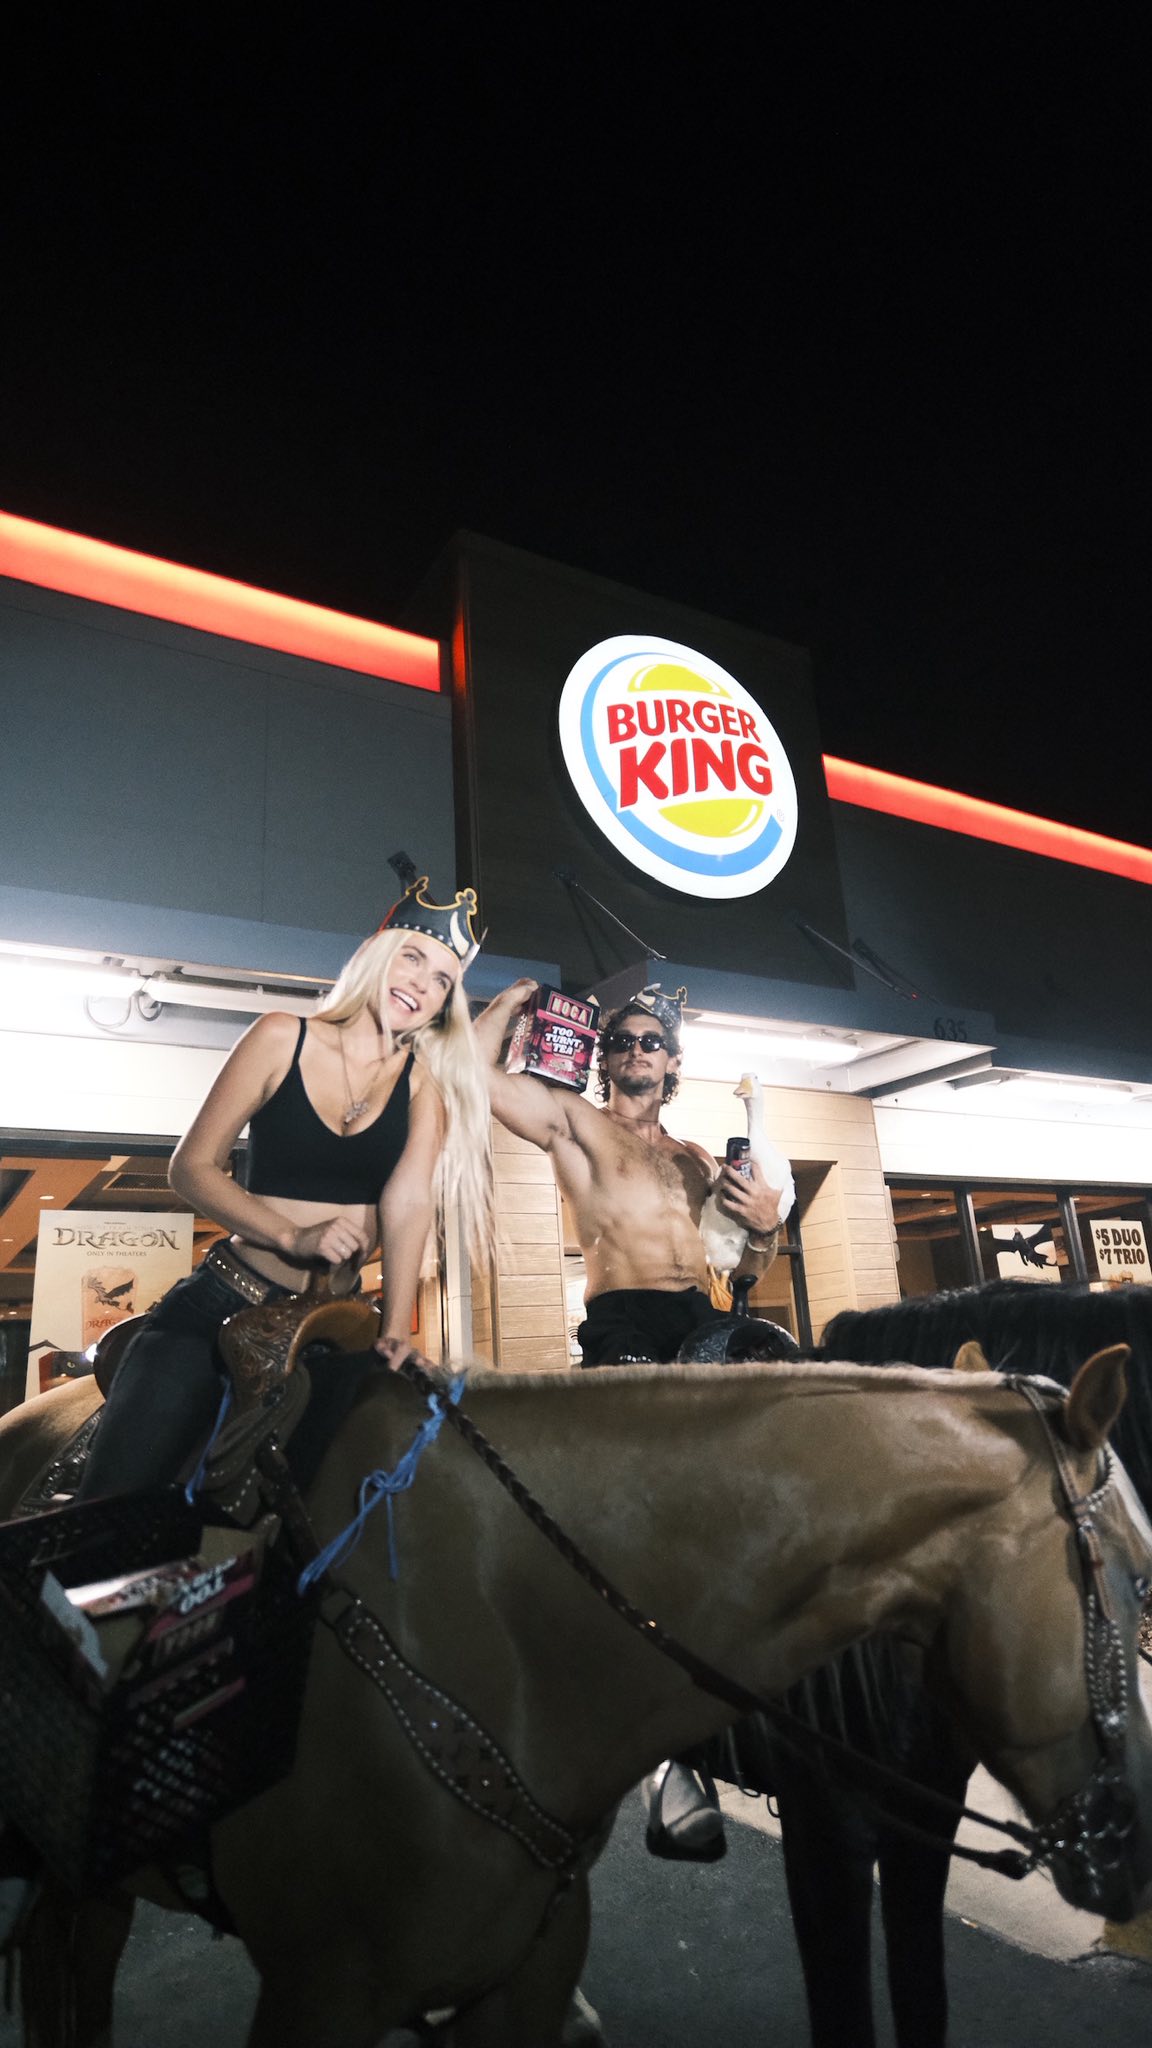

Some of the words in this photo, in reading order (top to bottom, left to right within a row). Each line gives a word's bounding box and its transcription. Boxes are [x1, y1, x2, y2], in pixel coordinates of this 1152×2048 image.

[607, 699, 761, 744] BURGER
[619, 738, 772, 808] KING
[551, 1025, 574, 1038] TOO
[933, 1017, 967, 1041] 635
[545, 1033, 582, 1048] TURNT
[552, 1043, 574, 1055] TEA
[52, 1227, 180, 1251] DRAGON
[1095, 1228, 1111, 1246] $5
[1111, 1228, 1142, 1246] DUO
[1099, 1248, 1112, 1265] $7
[1113, 1248, 1146, 1265] TRIO
